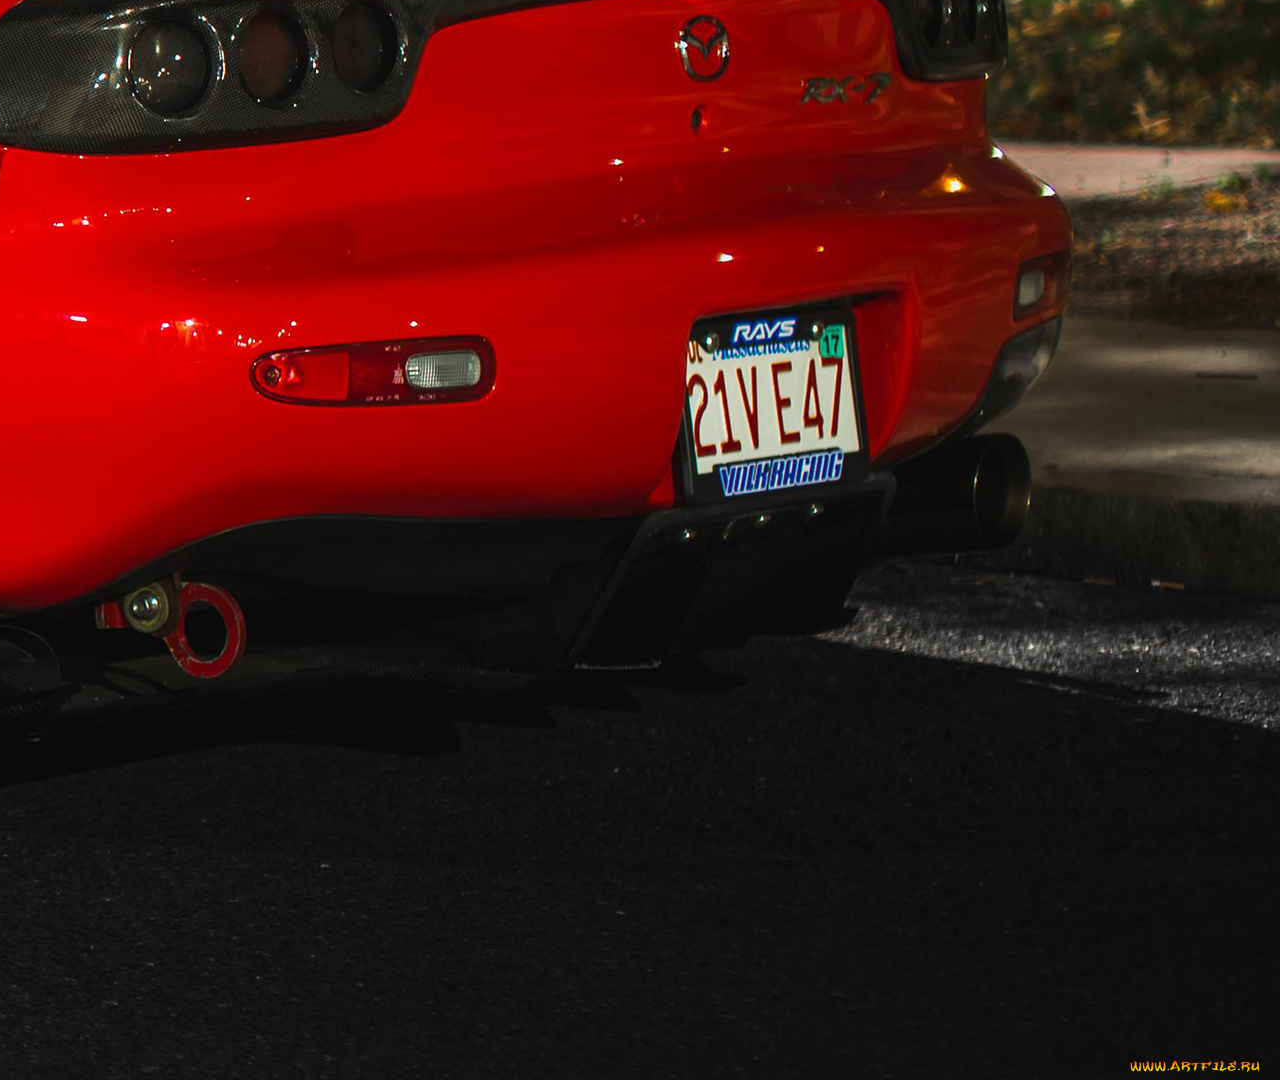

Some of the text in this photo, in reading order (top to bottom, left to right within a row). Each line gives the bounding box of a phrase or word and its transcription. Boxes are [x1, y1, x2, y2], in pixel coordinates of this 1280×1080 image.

[800, 73, 890, 104] RX-7
[733, 318, 796, 344] RAYS
[823, 335, 840, 354] 17
